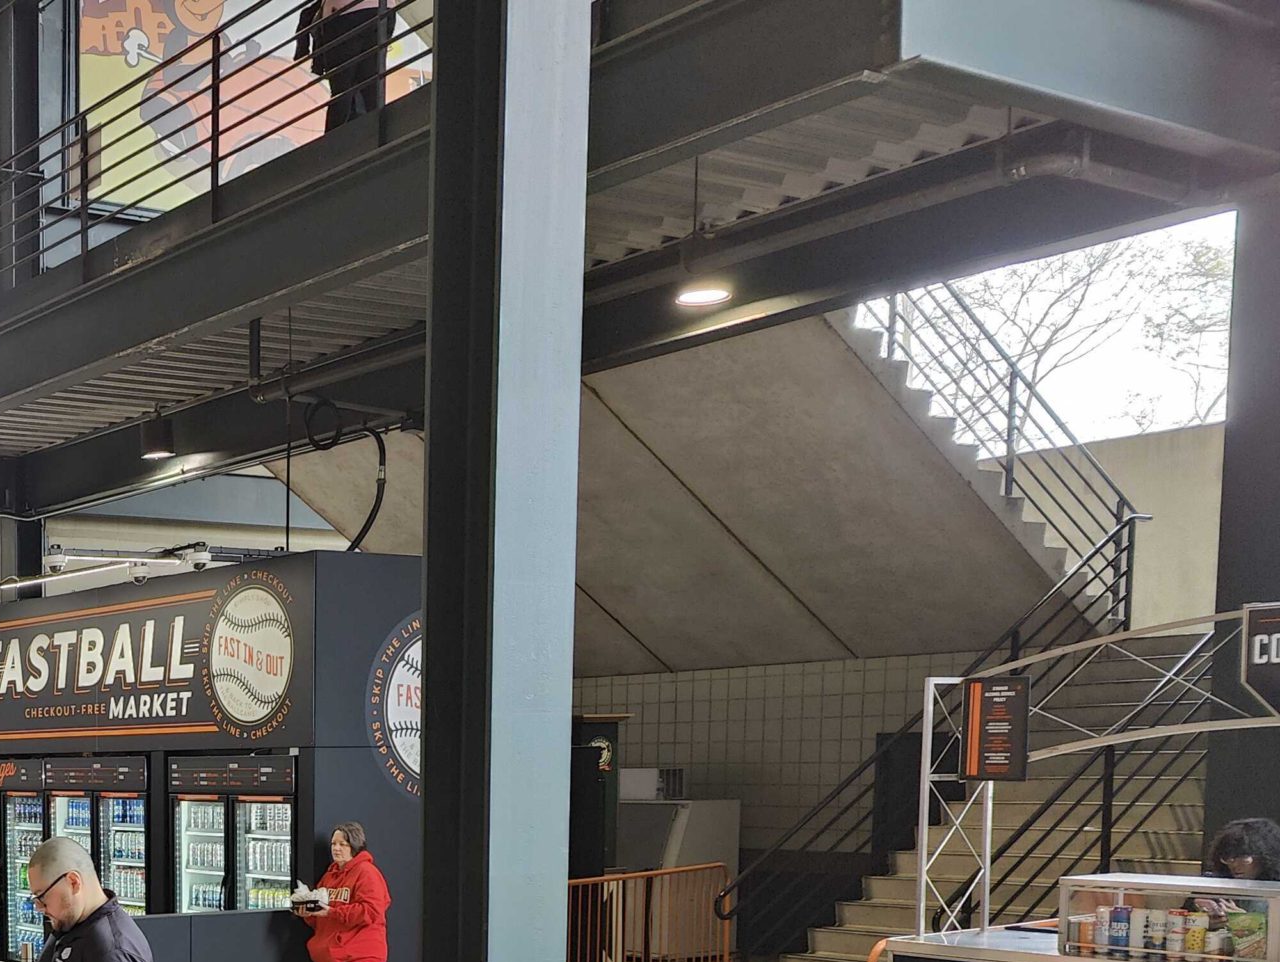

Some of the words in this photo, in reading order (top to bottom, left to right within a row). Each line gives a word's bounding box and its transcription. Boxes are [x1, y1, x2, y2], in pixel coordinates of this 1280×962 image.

[201, 623, 211, 654] SKIP
[209, 598, 223, 619] THE
[222, 575, 242, 596] LINE
[251, 570, 293, 605] CHECKOUT
[218, 635, 241, 660] FAST
[243, 643, 254, 667] IN
[255, 650, 264, 671] &
[265, 655, 285, 678] OUT
[372, 668, 384, 704] SKIP
[381, 637, 401, 663] THE
[401, 619, 421, 638] LIN
[24, 703, 107, 719] CHECKOUT-FREE
[108, 691, 193, 719] MARKET
[202, 669, 212, 697] SKIP
[209, 700, 223, 721] THE
[222, 720, 241, 739] LINE
[250, 699, 293, 740] CHECKOUT
[397, 684, 421, 709] FAS
[372, 721, 387, 755] SKIP
[385, 758, 406, 783] THE
[406, 781, 421, 796] LI
